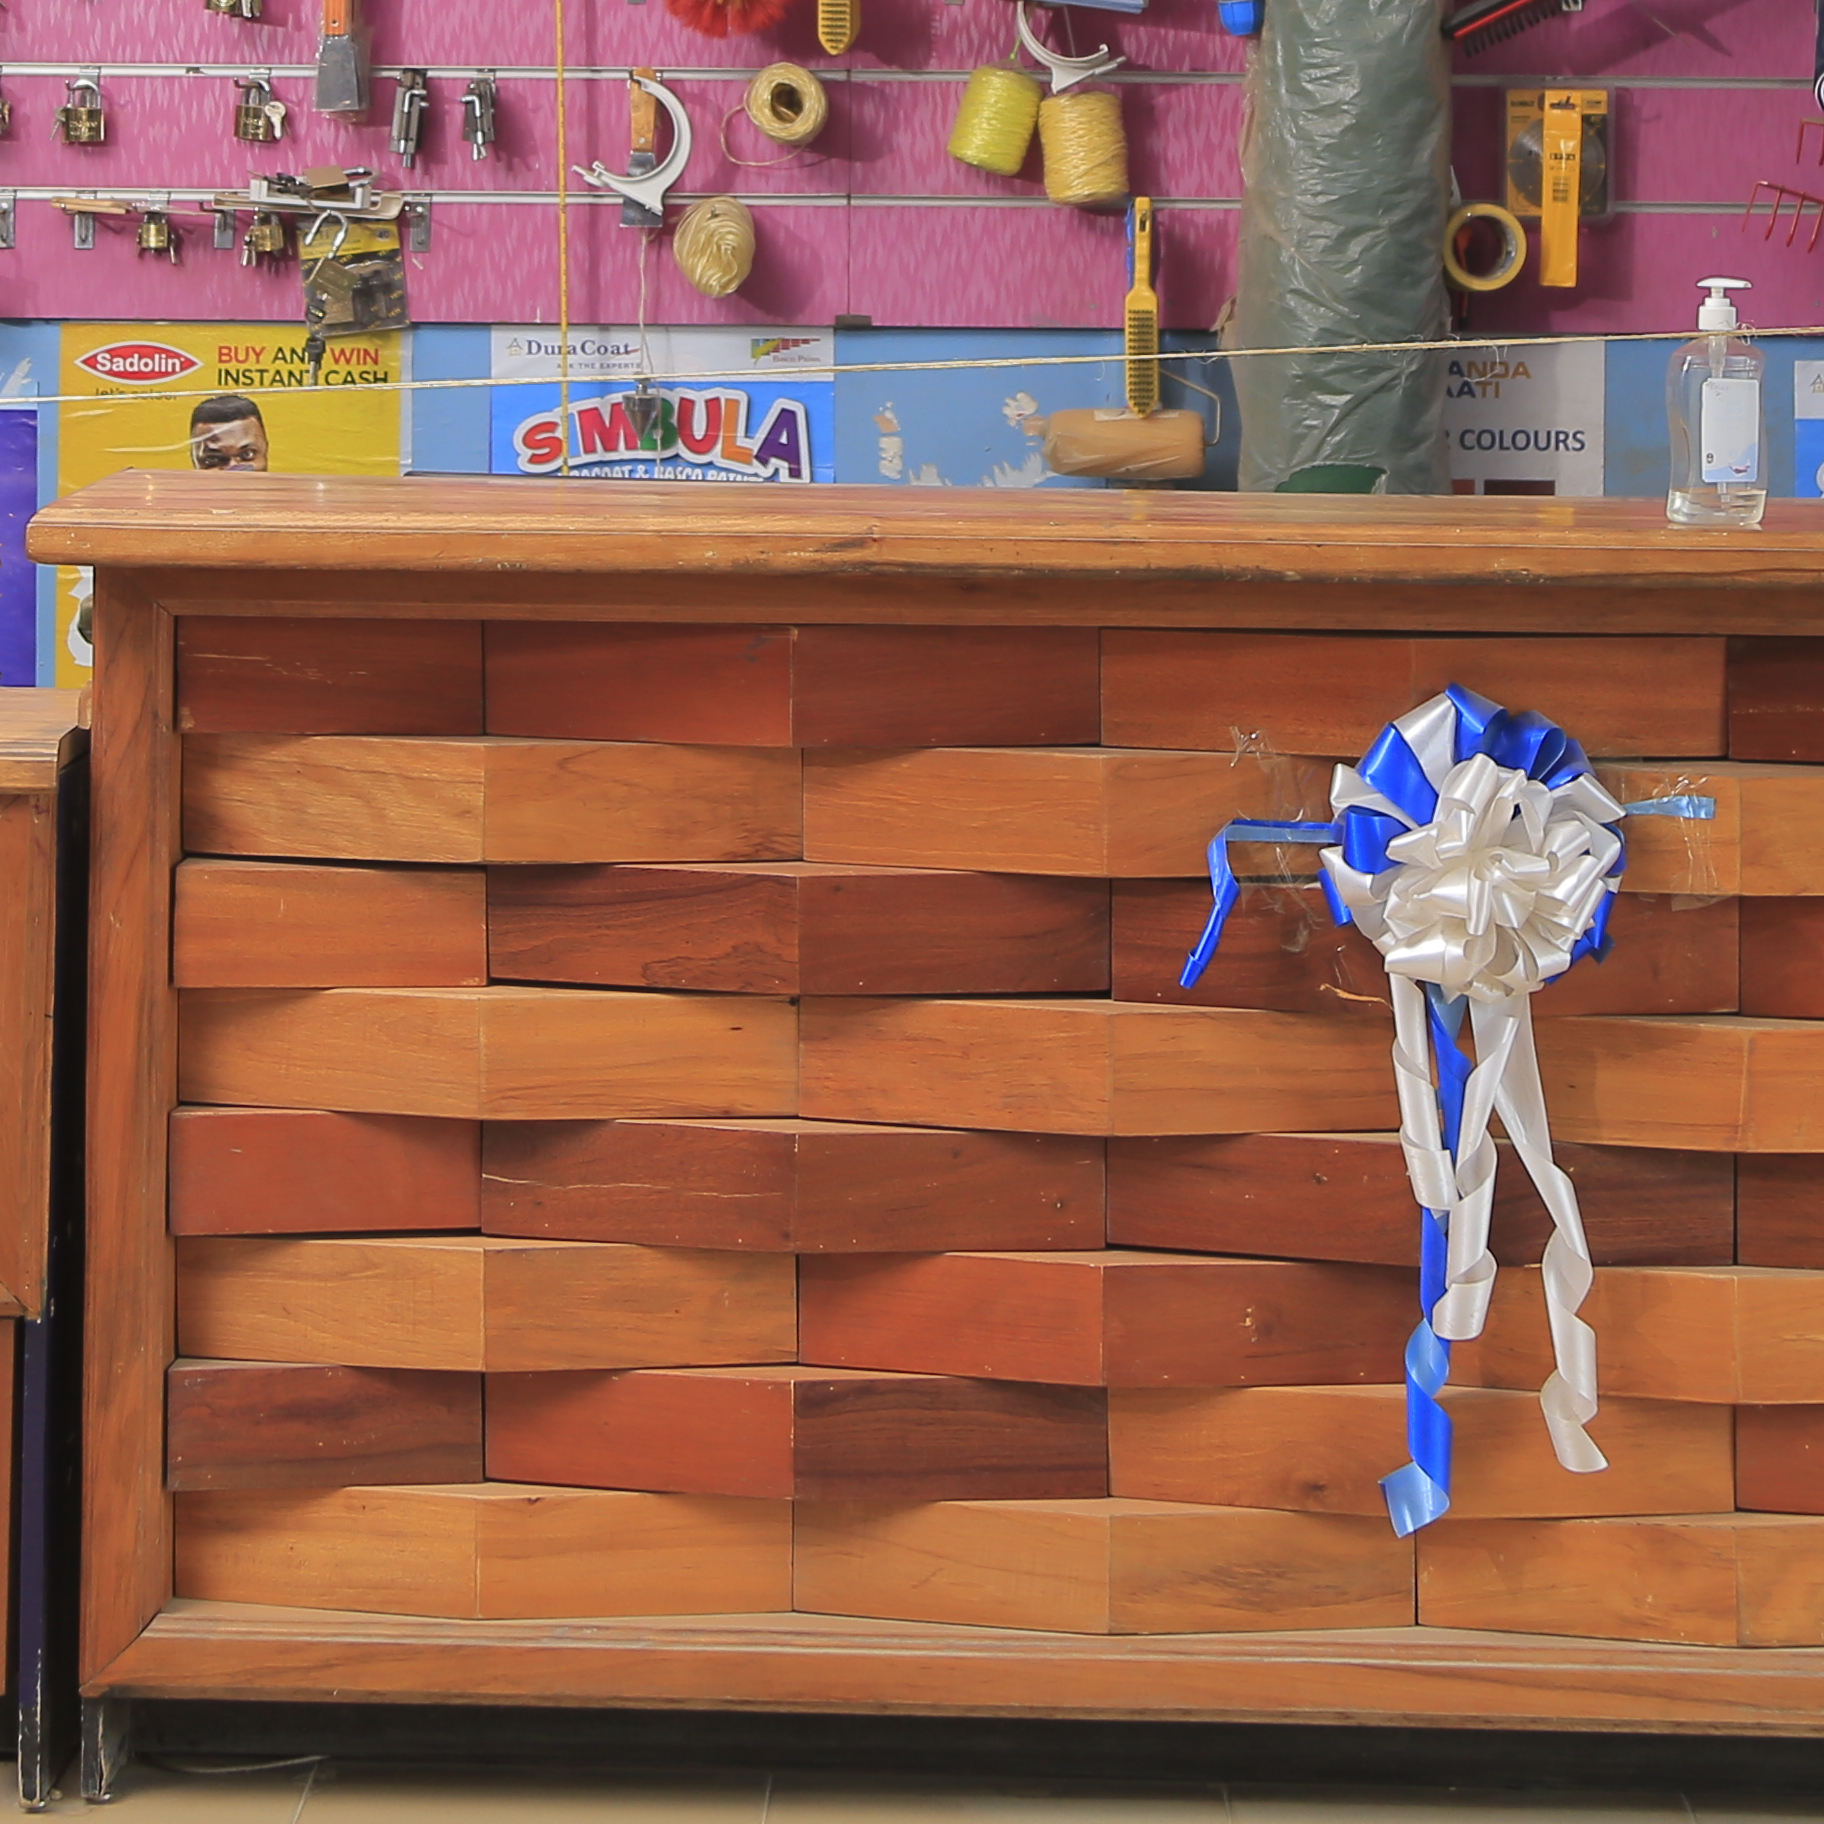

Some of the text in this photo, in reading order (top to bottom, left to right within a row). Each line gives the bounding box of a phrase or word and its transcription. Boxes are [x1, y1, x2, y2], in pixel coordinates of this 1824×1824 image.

[96, 353, 182, 373] Sadolin
[217, 346, 379, 365] BUY WIN
[325, 369, 388, 385] CASH
[1459, 428, 1586, 452] COLOURS
